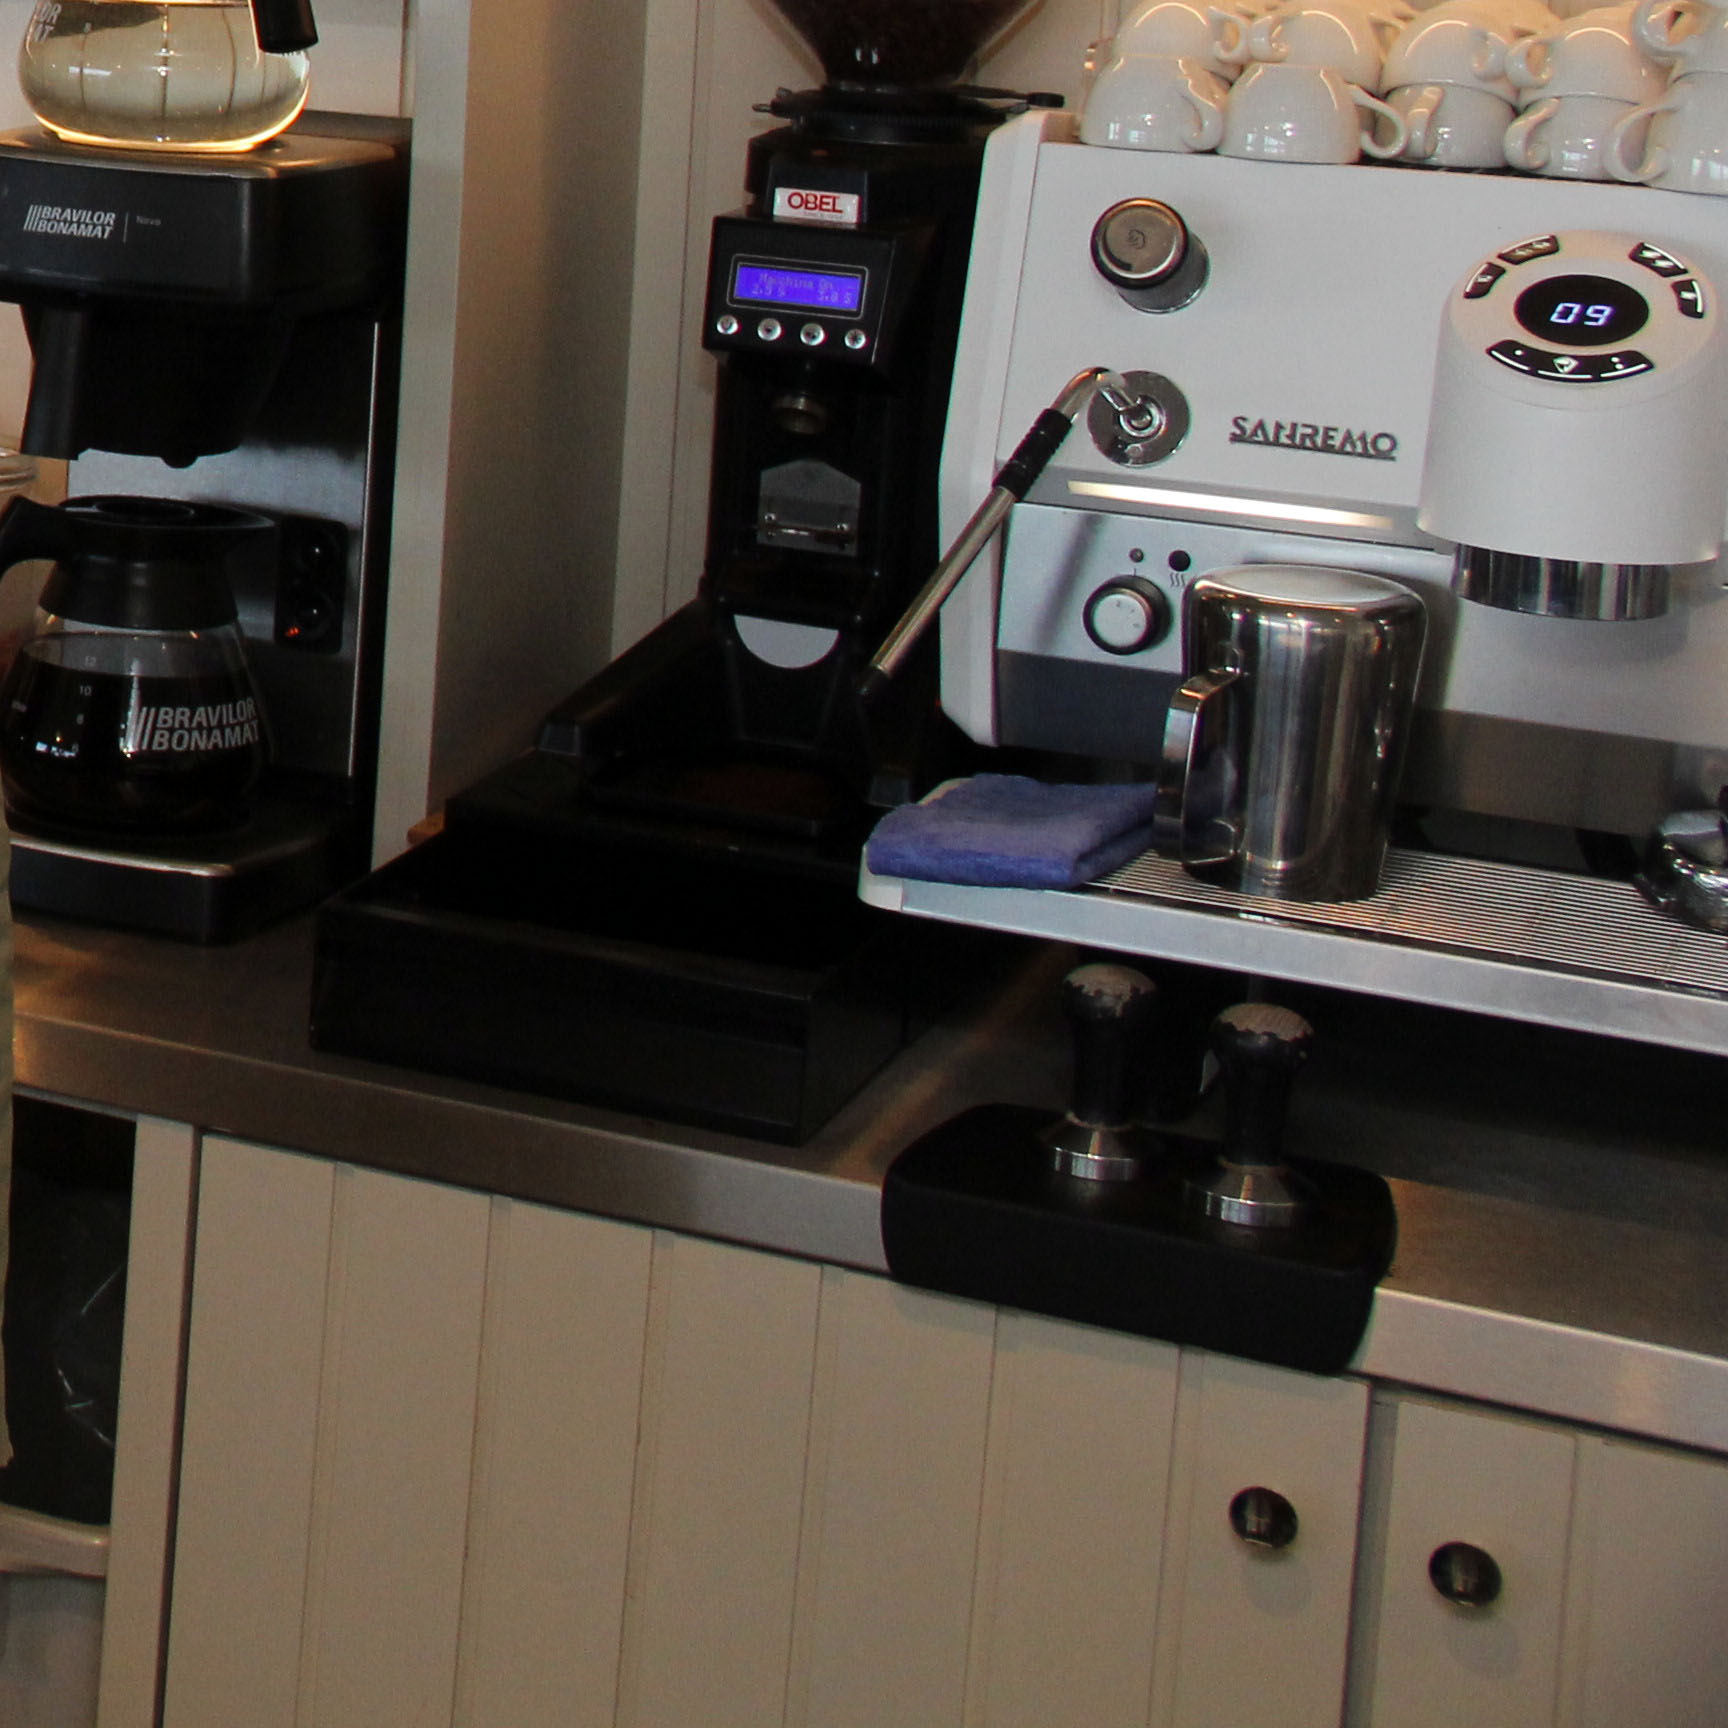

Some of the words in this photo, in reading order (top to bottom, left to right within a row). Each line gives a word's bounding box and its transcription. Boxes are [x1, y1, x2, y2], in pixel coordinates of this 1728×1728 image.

[787, 191, 843, 214] OBEL
[41, 206, 116, 226] BRAVILOR
[37, 219, 113, 240] BONAMAT
[1550, 302, 1614, 326] 09
[1229, 415, 1397, 459] SANREMO
[156, 697, 255, 729] BRAVILOR
[152, 719, 259, 752] BONAMAT
